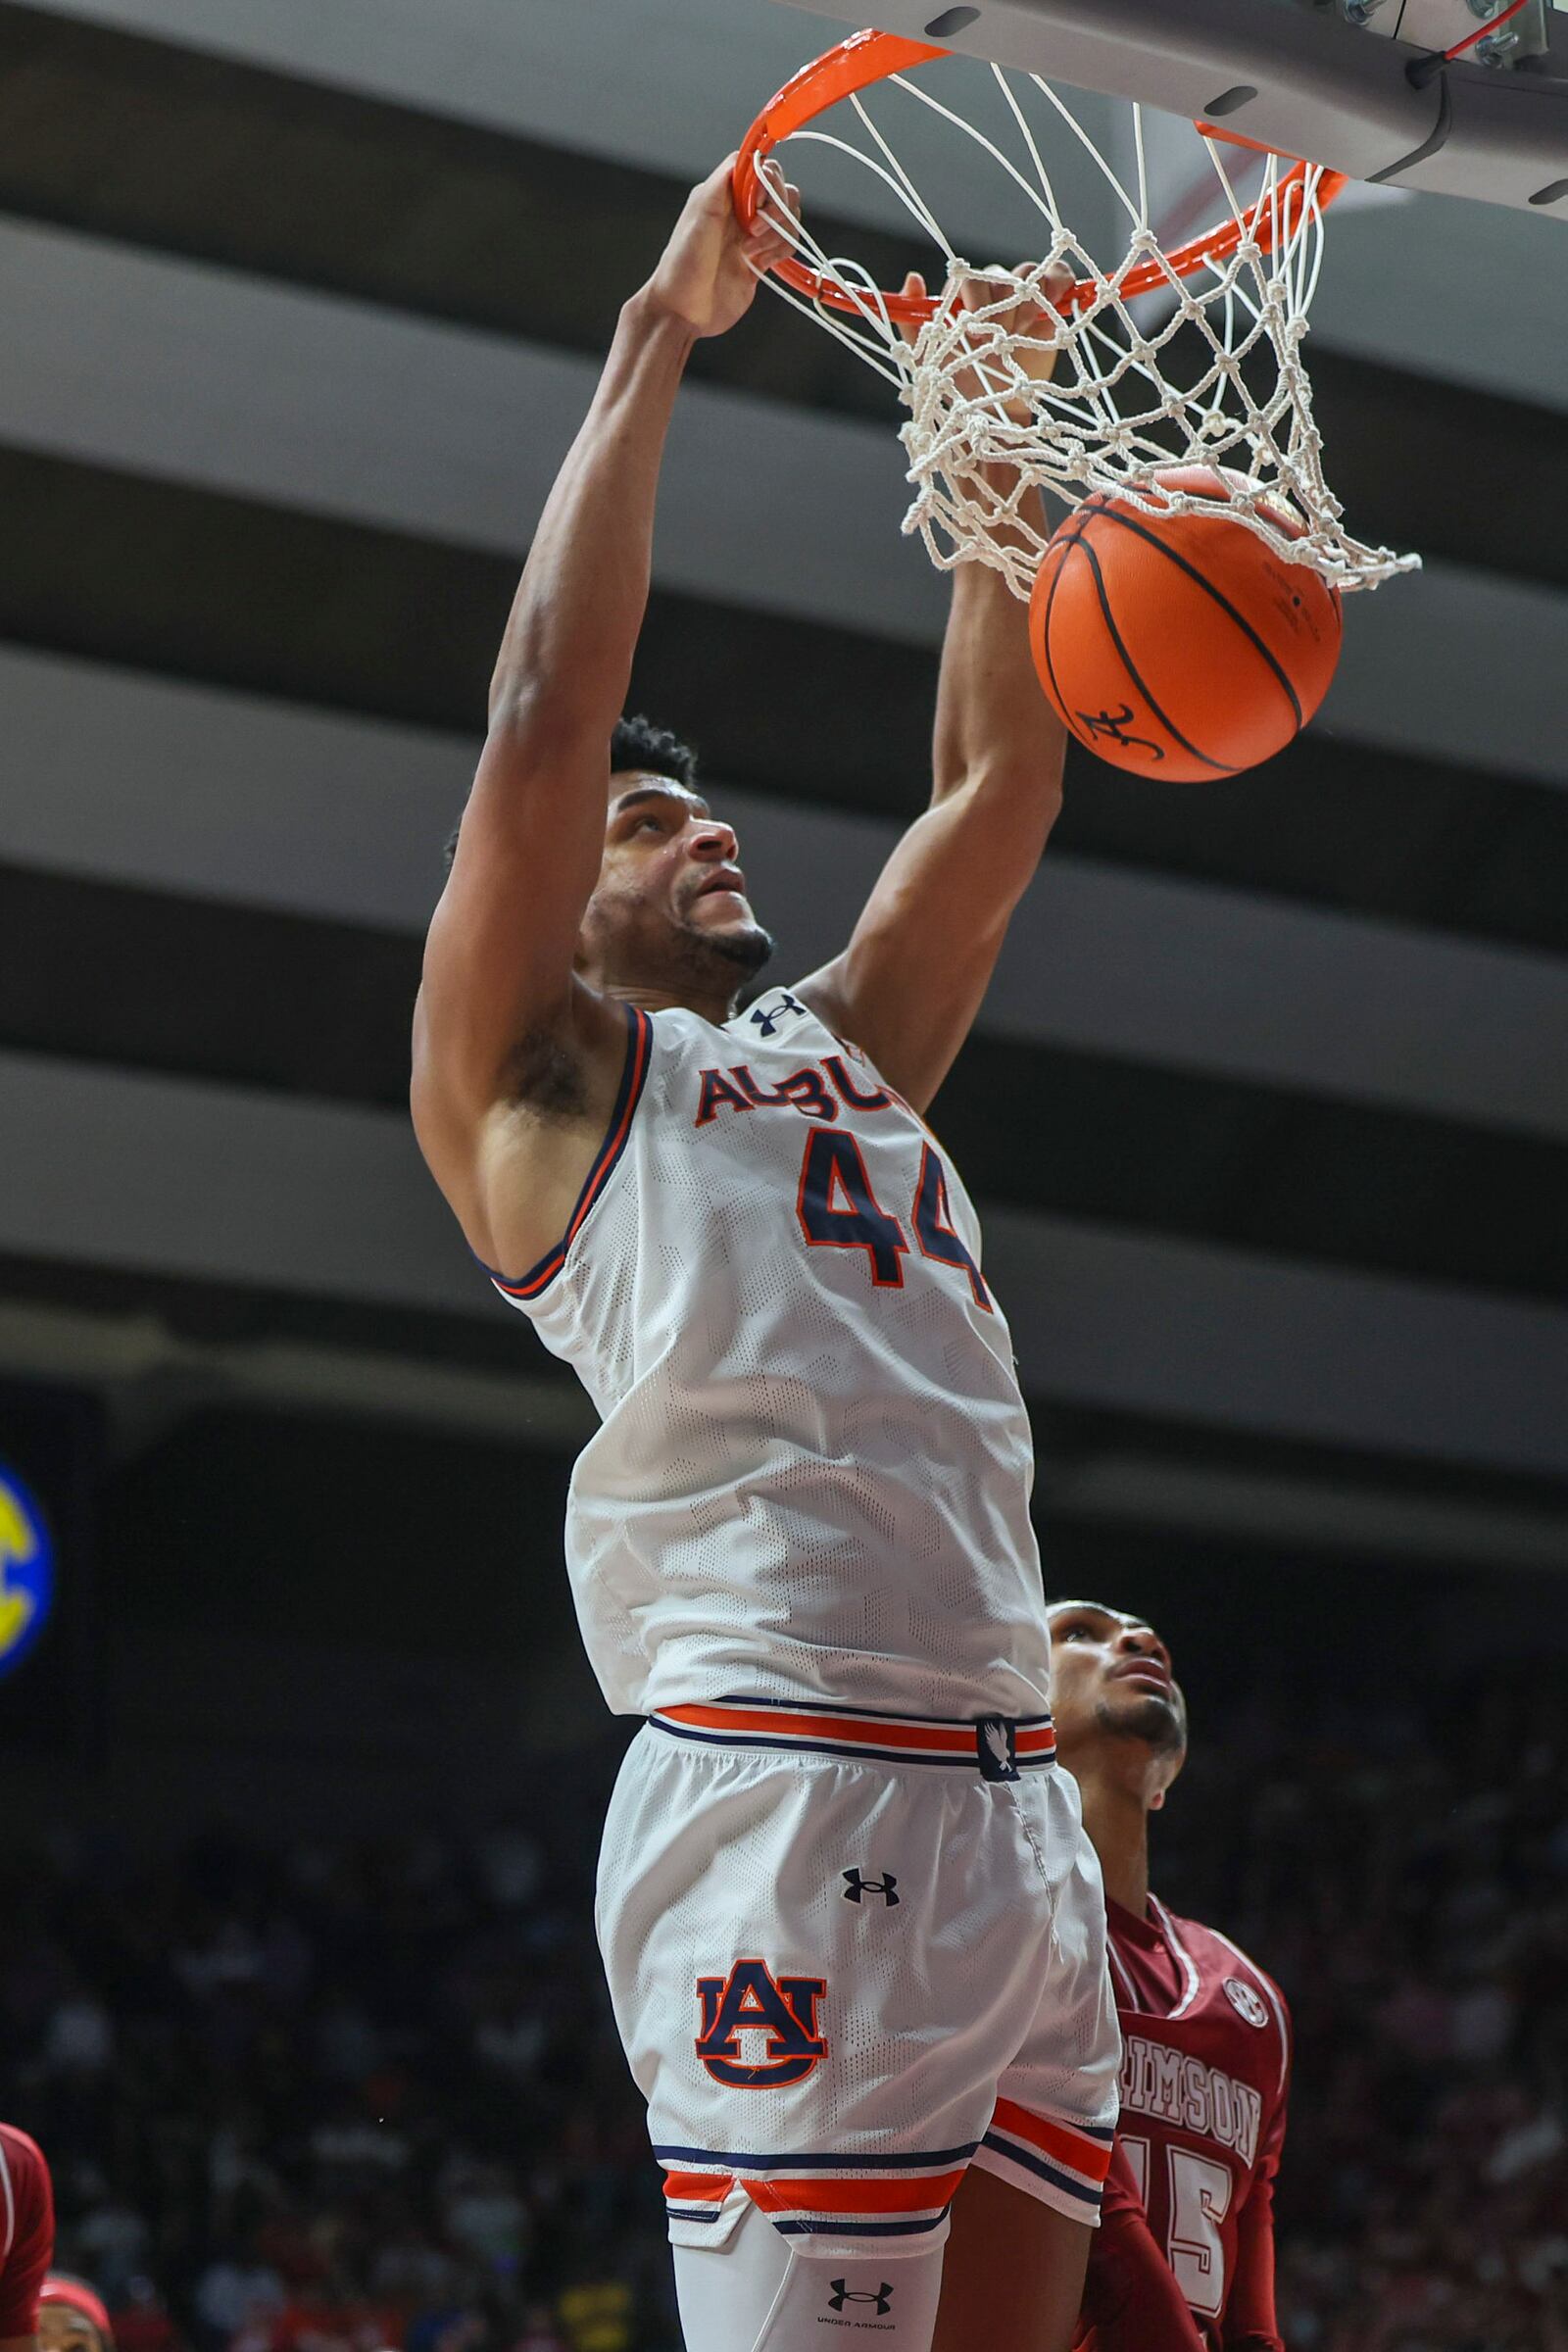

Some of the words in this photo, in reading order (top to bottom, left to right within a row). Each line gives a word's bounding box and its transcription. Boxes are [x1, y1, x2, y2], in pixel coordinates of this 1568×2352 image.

[796, 1126, 994, 1314] 44
[817, 2316, 852, 2328] UNDER
[854, 2321, 896, 2330] ARMOUR
